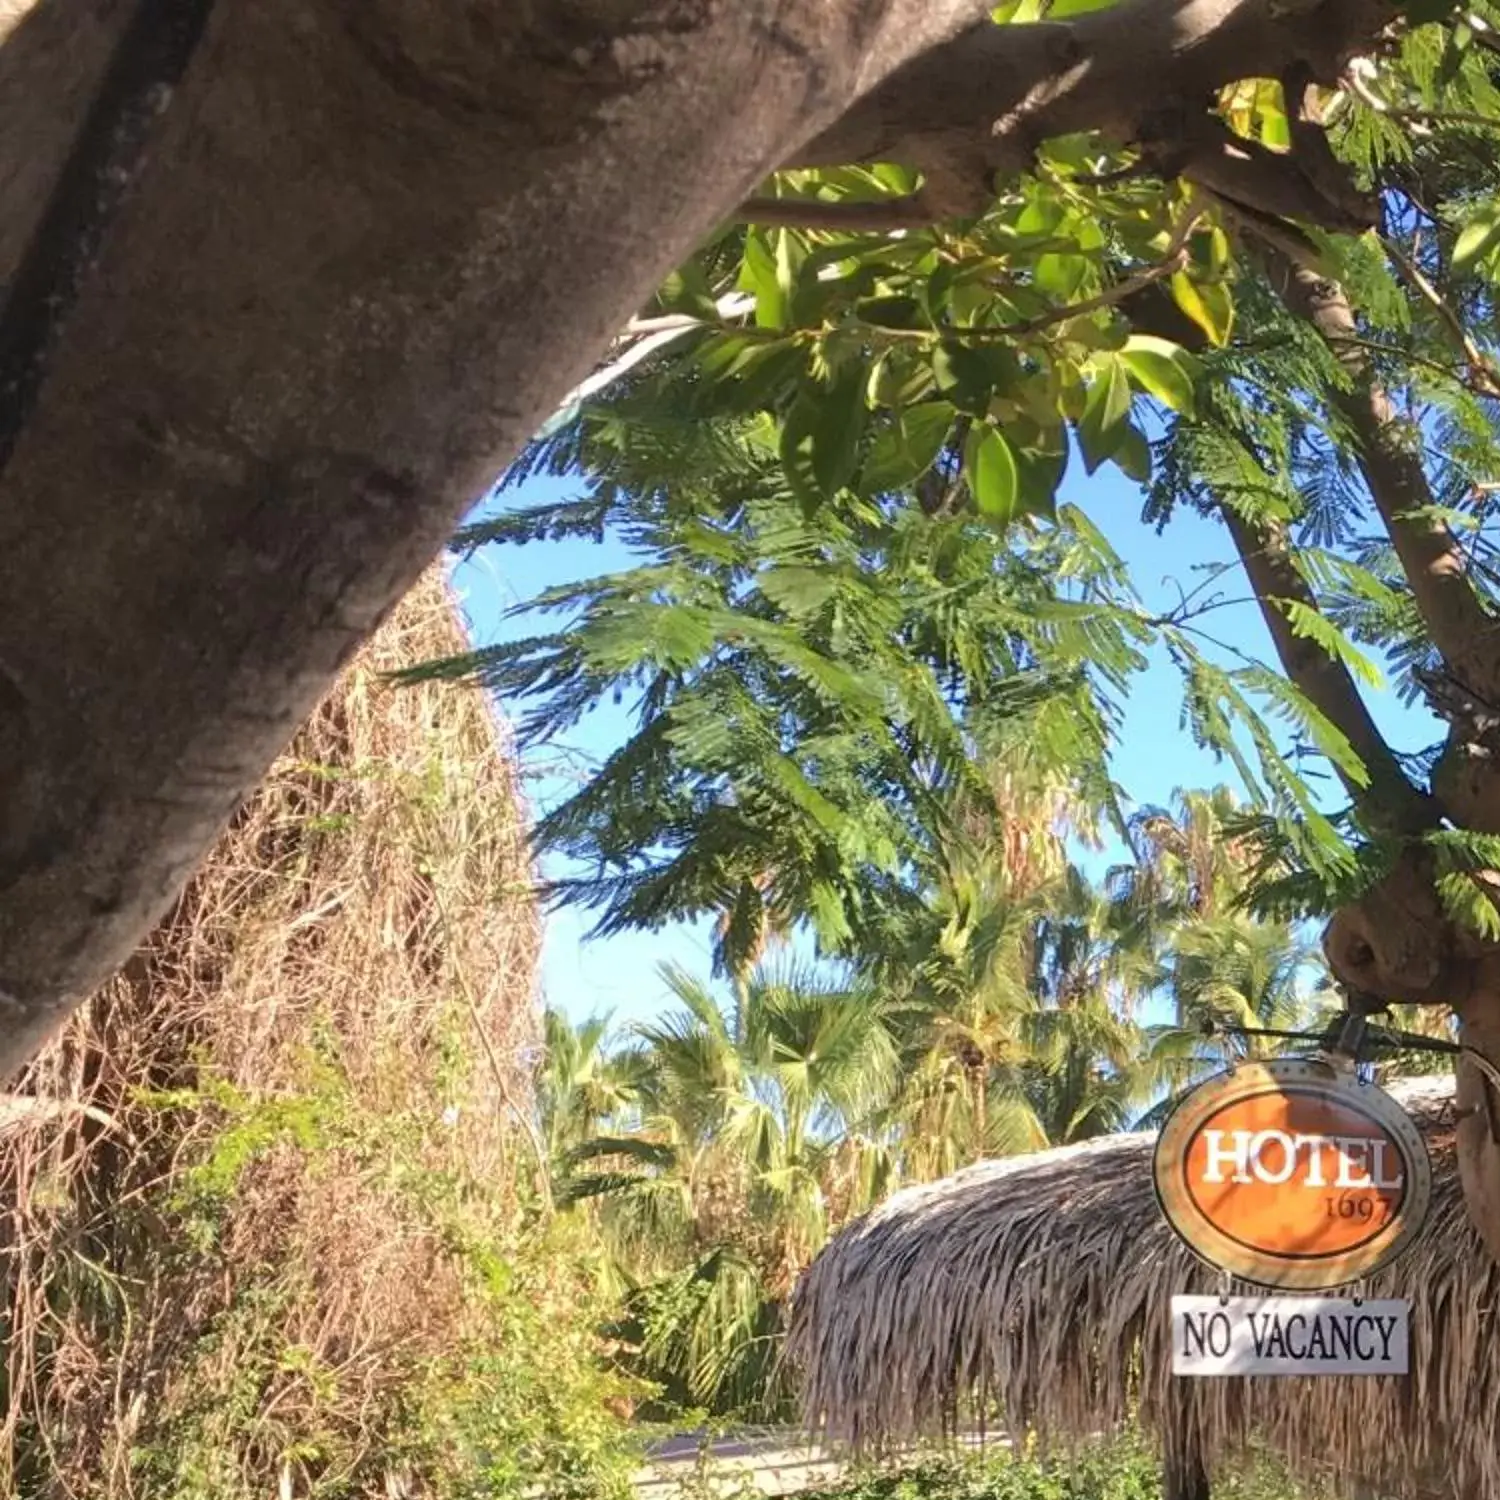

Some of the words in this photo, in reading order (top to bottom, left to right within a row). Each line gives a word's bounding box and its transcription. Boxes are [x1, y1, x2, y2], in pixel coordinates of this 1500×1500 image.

[1202, 1129, 1403, 1188] HOTEL
[1182, 1312, 1232, 1358] NO
[1247, 1313, 1398, 1361] VACANCY
